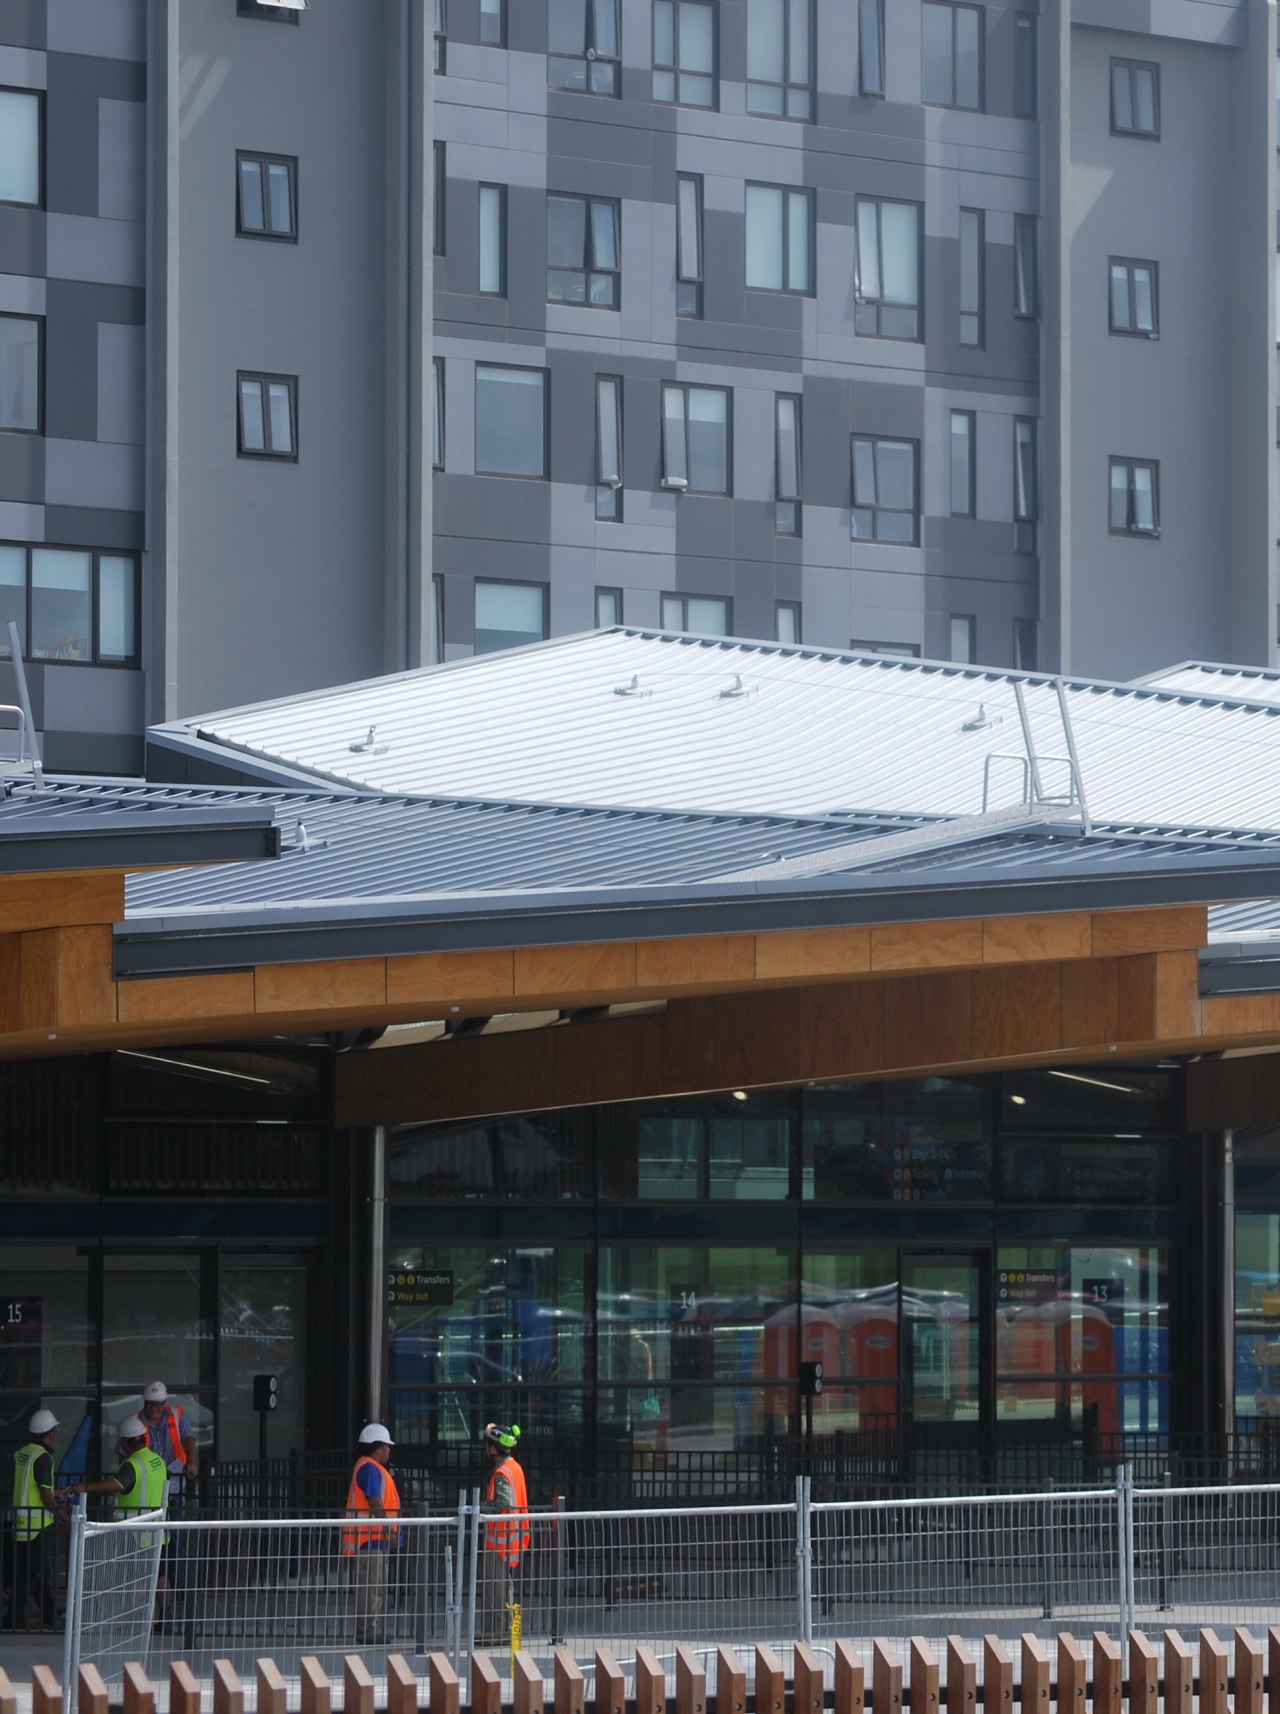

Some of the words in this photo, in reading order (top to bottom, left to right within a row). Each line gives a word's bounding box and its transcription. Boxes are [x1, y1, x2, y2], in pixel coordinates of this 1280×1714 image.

[417, 1275, 450, 1285] Transfers
[1026, 1273, 1055, 1283] Transfers
[397, 1292, 414, 1303] Way
[415, 1292, 429, 1300] out
[680, 1291, 696, 1310] 14
[1092, 1285, 1108, 1303] 13
[8, 1303, 22, 1323] 15
